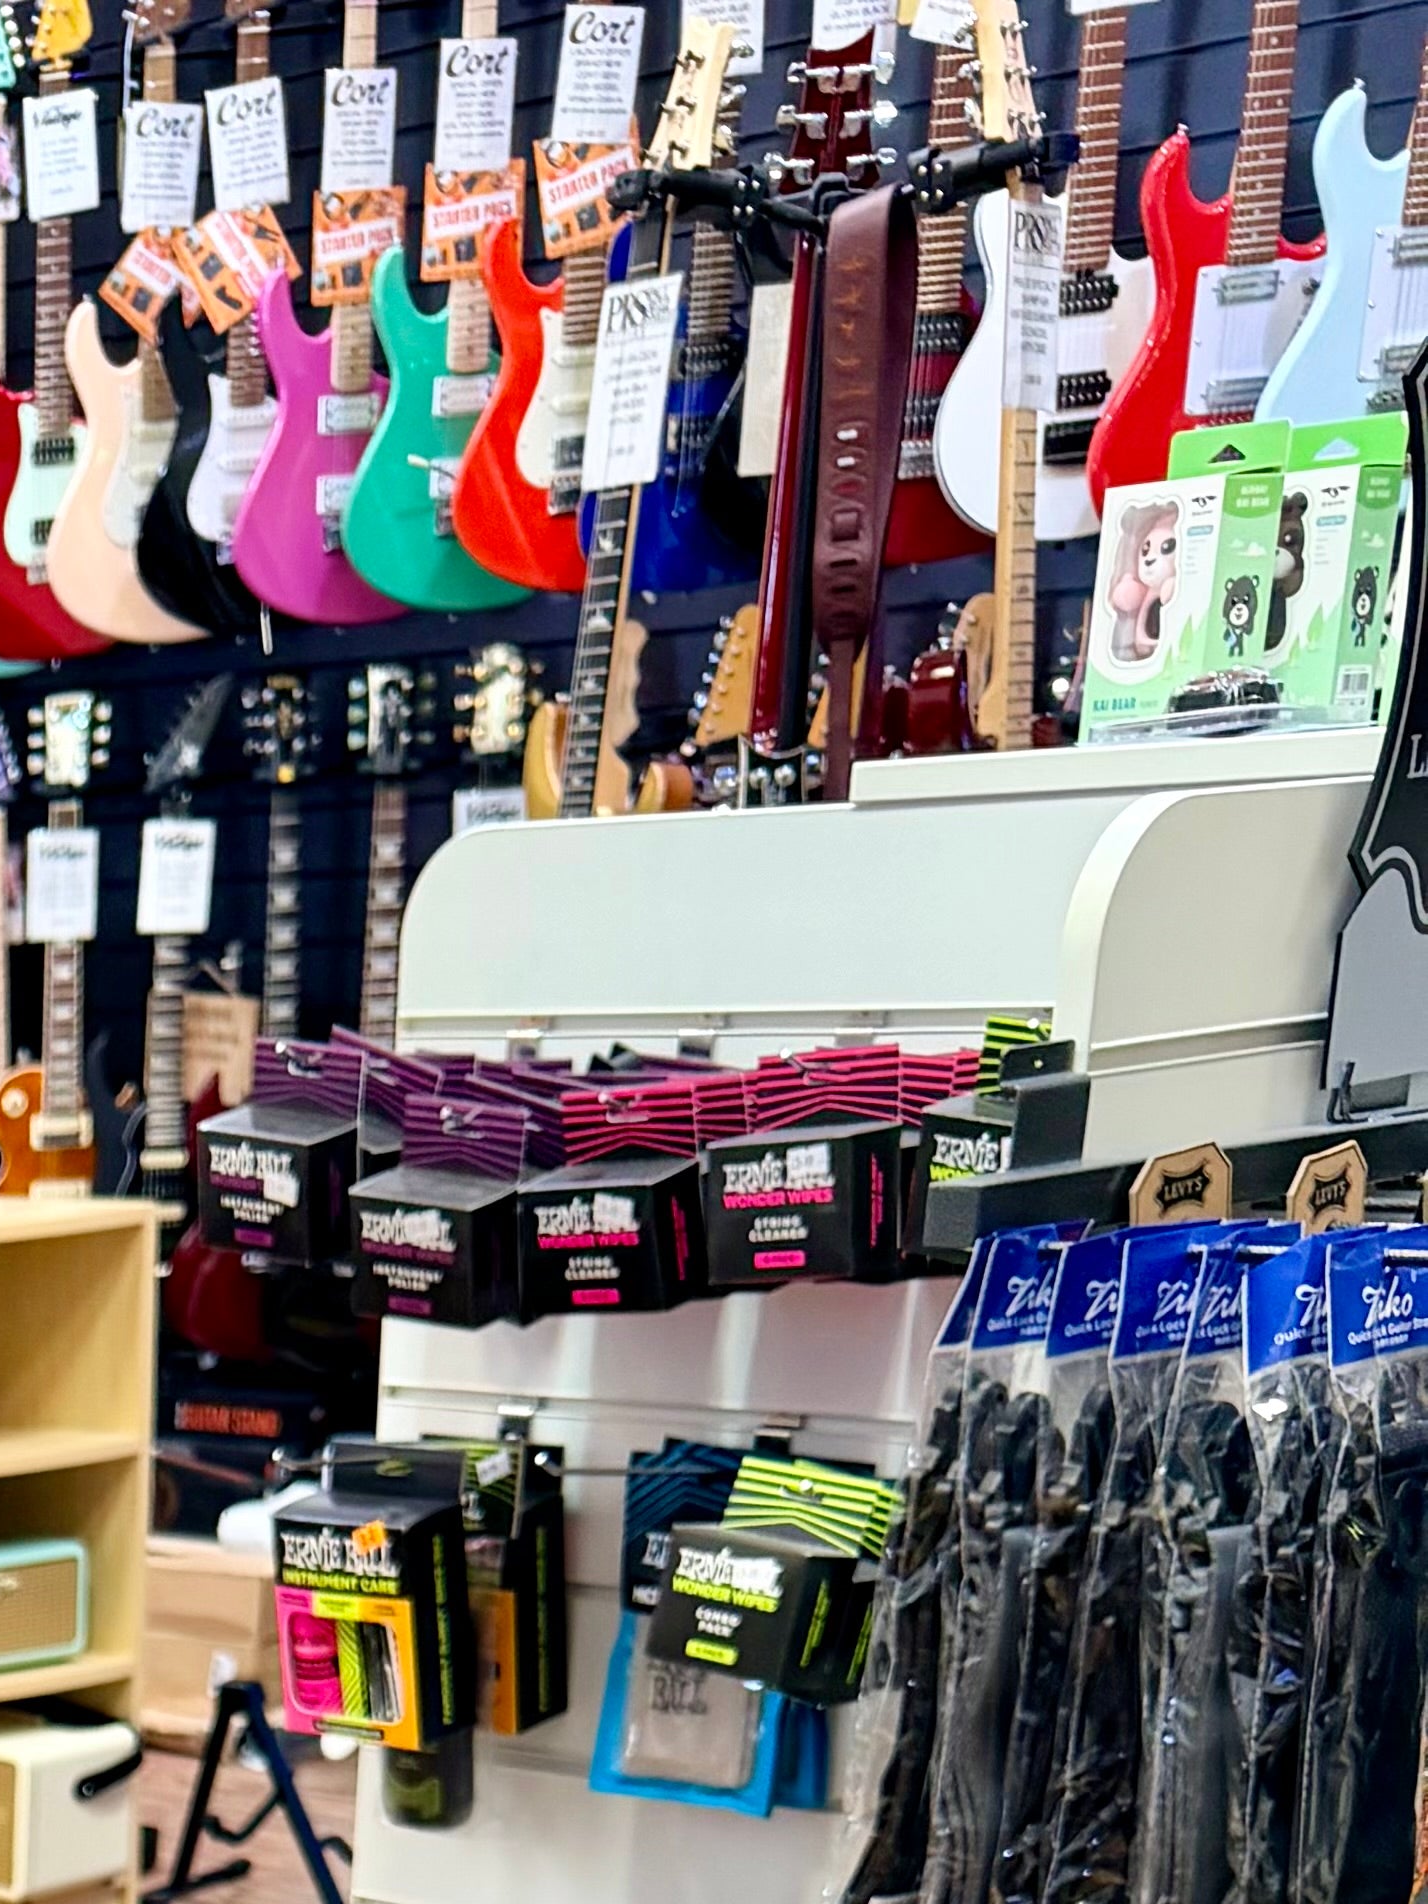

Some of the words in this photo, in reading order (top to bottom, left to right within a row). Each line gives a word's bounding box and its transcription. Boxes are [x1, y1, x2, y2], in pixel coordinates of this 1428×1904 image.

[569, 11, 635, 45] Cort
[446, 45, 509, 77] Cort
[217, 87, 276, 126] Cort
[332, 75, 389, 107] Cort
[136, 107, 195, 138] Cort
[932, 1131, 998, 1174] ERNIE
[722, 1151, 785, 1193] ERNIE
[1163, 1174, 1204, 1201] LEVY'S
[722, 1190, 786, 1211] WONDER
[788, 1186, 835, 1205] WIPES
[533, 1195, 591, 1236] ERNIE
[537, 1233, 594, 1250] WONDER
[595, 1230, 641, 1248] WIPES
[1362, 1275, 1413, 1329] Tiko
[280, 1526, 343, 1571] ERNIE
[282, 1569, 359, 1592] INSTRUMENT
[359, 1576, 400, 1595] CARE
[672, 1574, 732, 1604] WONDER
[732, 1589, 781, 1614] WIPES
[694, 1603, 742, 1629] COMBO
[697, 1620, 736, 1639] PACK
